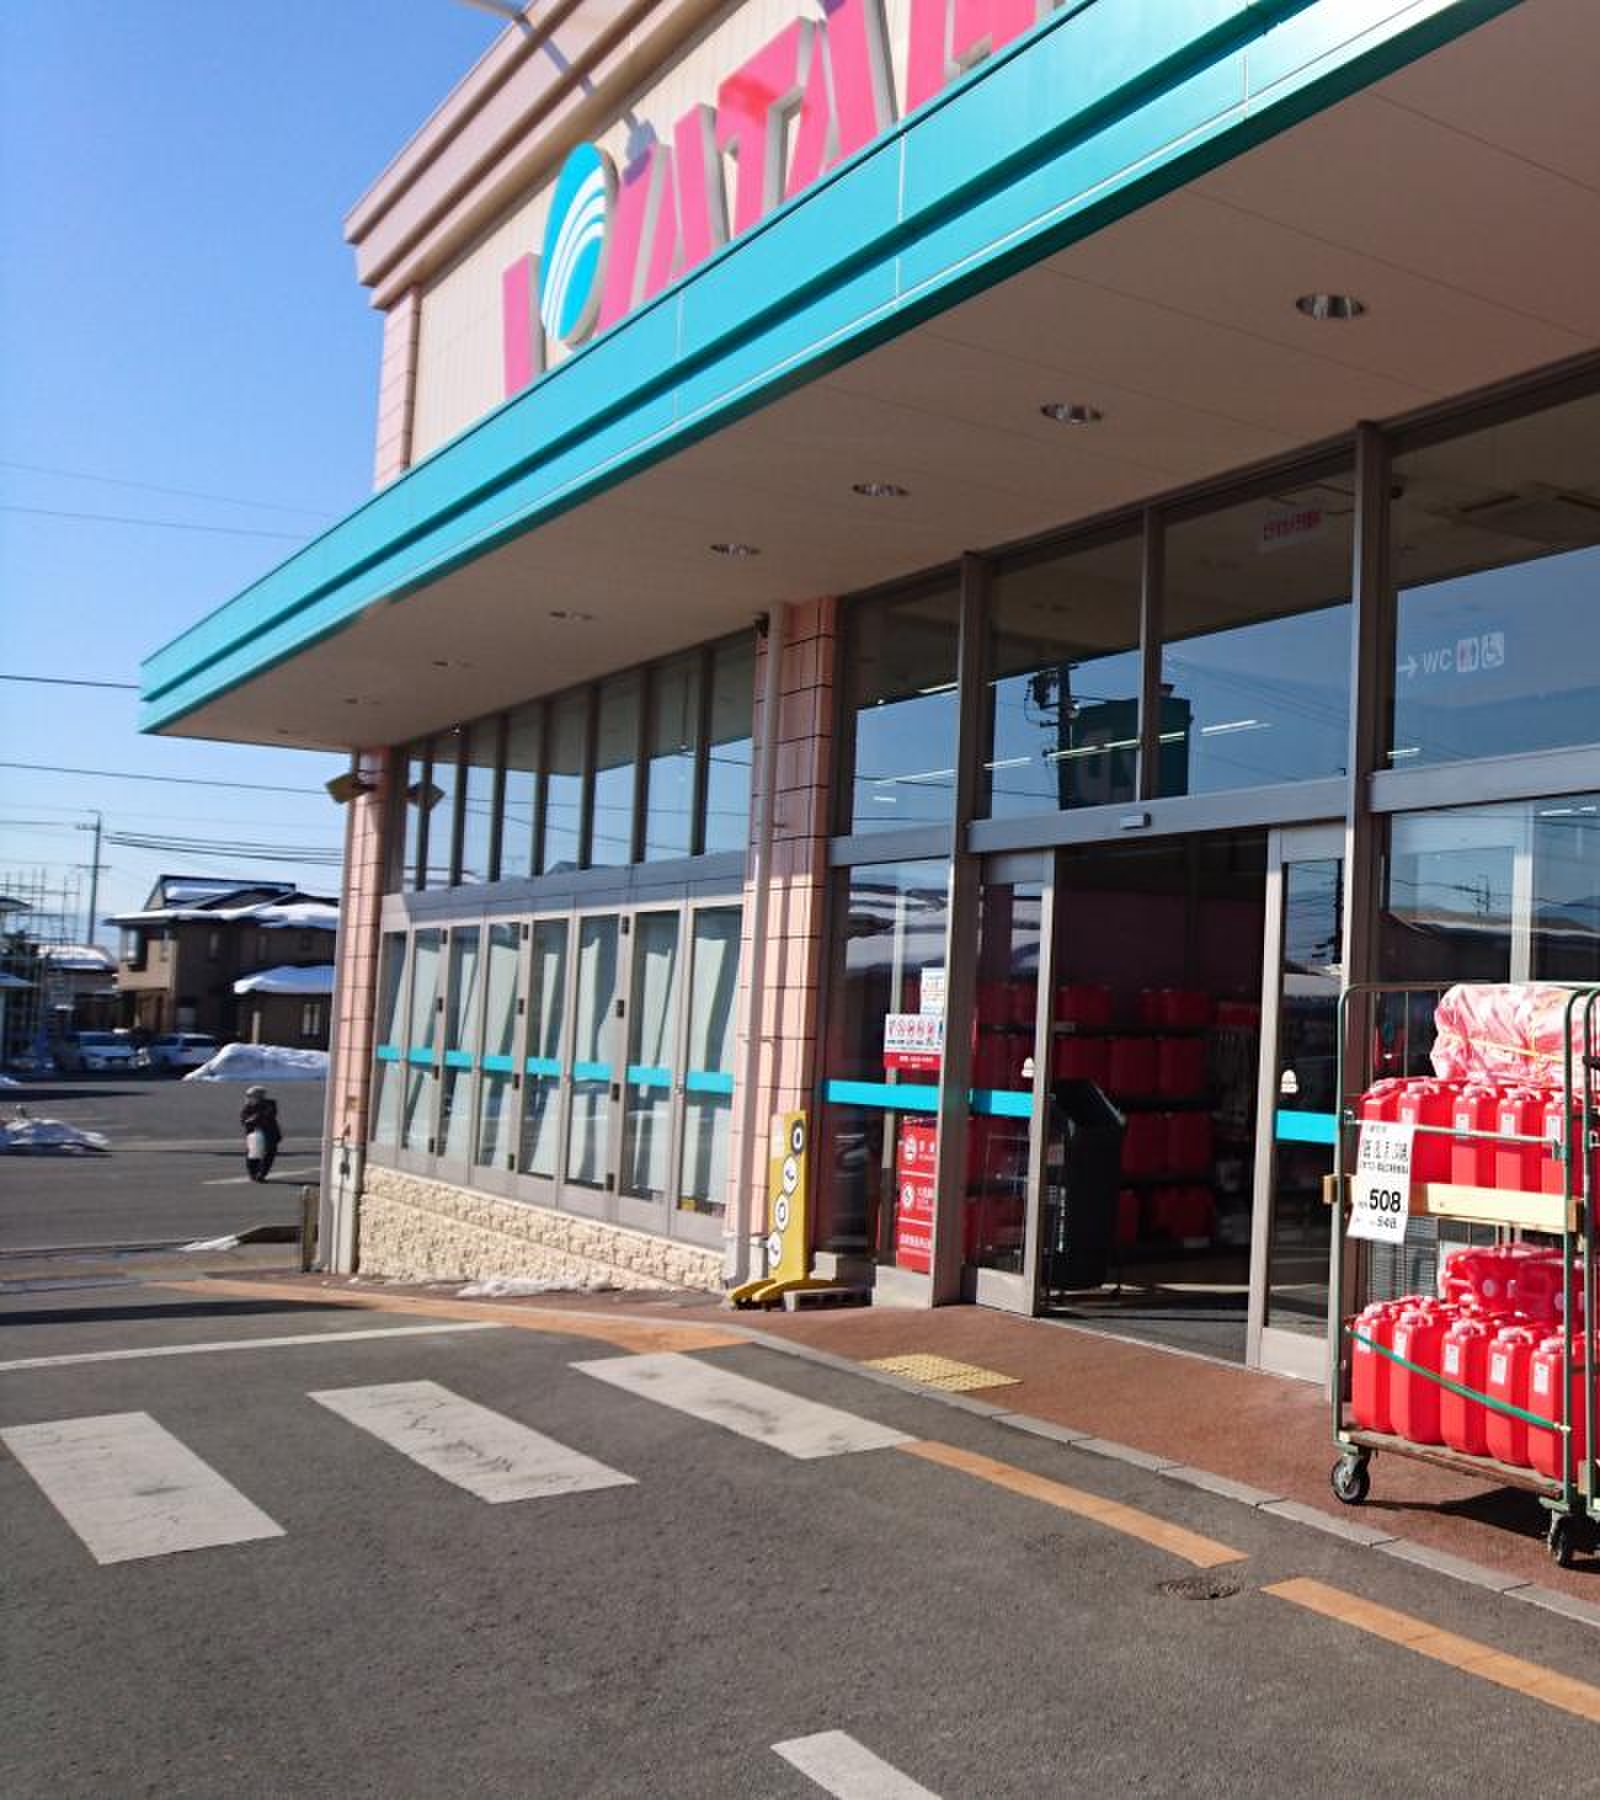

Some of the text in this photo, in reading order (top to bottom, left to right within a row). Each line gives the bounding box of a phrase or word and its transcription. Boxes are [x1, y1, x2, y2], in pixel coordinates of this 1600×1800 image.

[1423, 648, 1452, 673] WC
[1369, 1188, 1401, 1214] 508
[1376, 1215, 1398, 1230] 548
